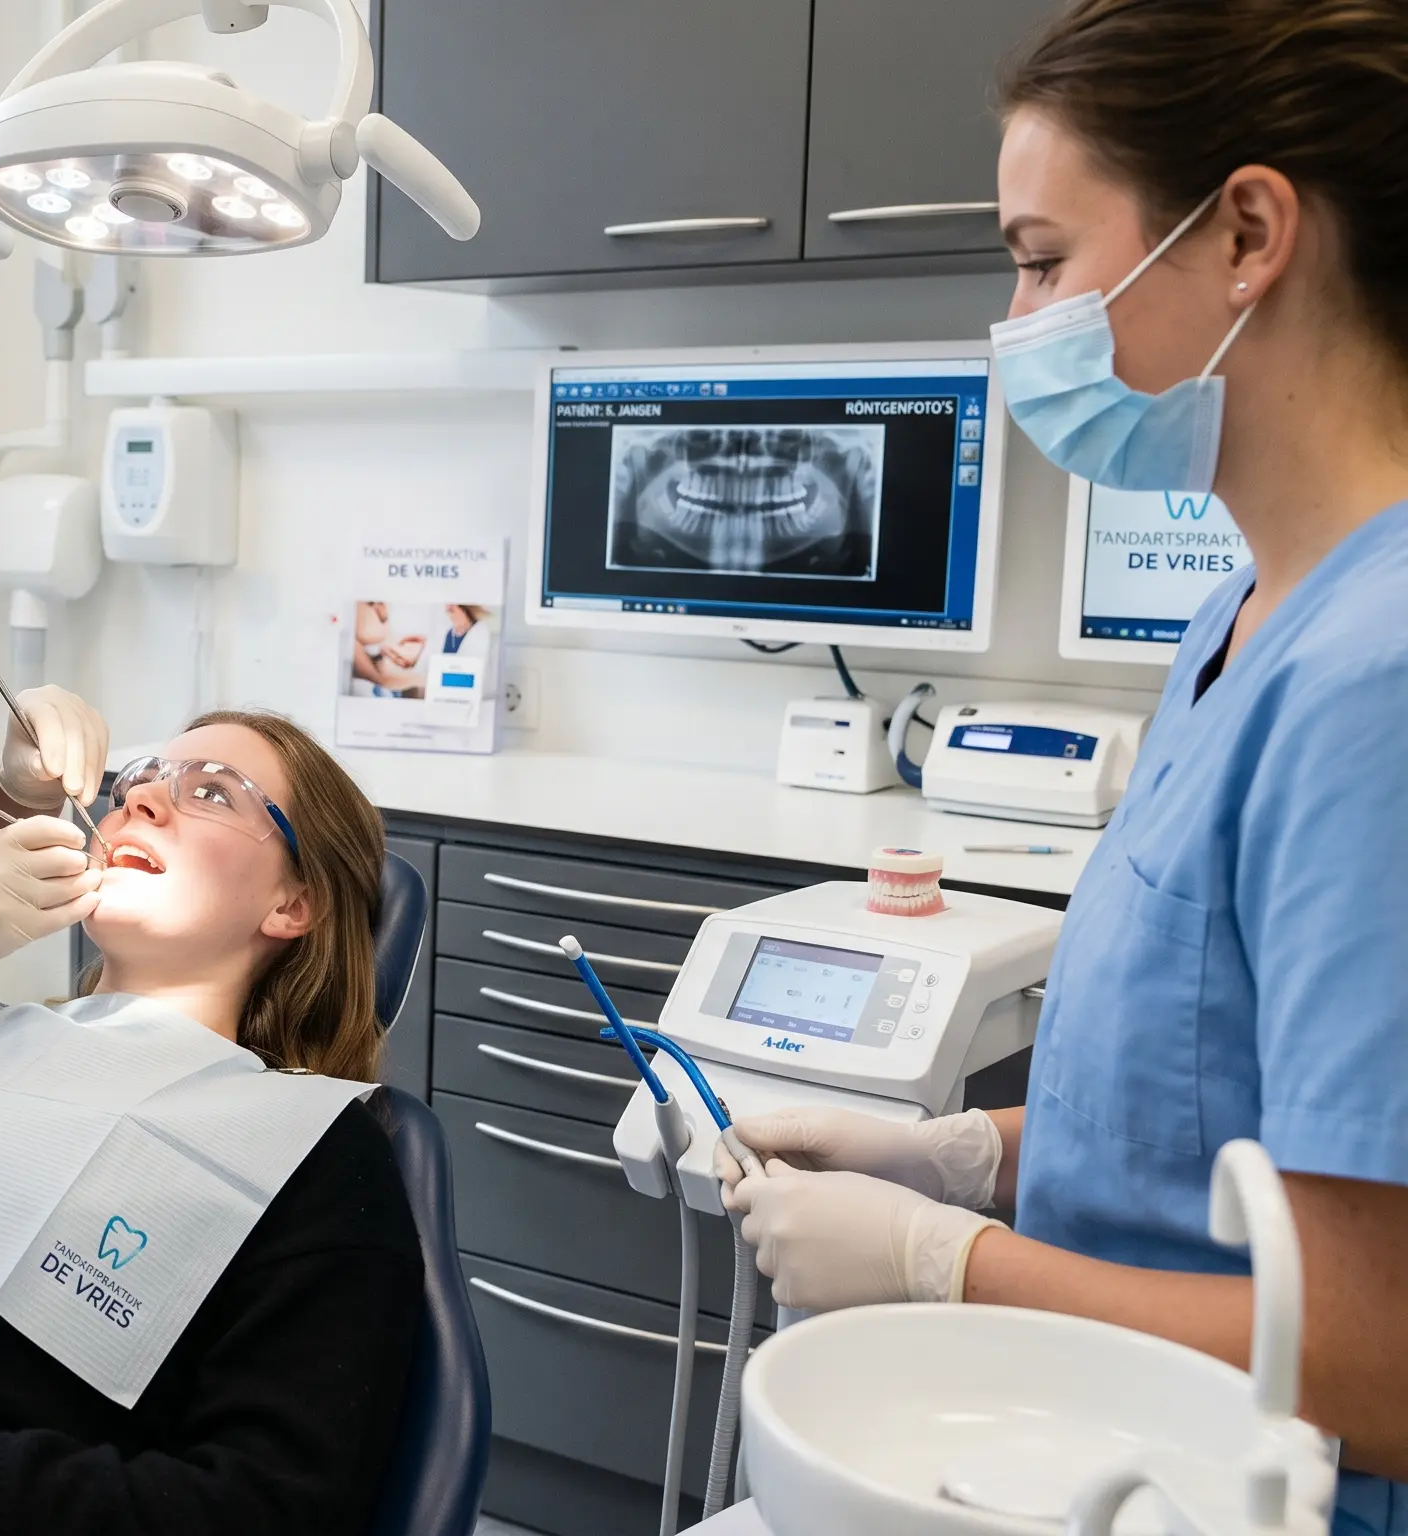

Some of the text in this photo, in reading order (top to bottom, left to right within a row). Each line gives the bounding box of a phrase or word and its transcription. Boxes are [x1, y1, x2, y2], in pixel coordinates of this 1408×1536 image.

[618, 403, 662, 417] JANSEN
[845, 399, 954, 416] RÖNTGENFOTO'S
[1093, 530, 1248, 548] TANDARTSPRAKT
[1128, 553, 1234, 572] DE VRIES
[388, 564, 460, 579] DE VRIES
[761, 1036, 805, 1053] A-dec
[40, 1252, 135, 1329] DE VRIES
